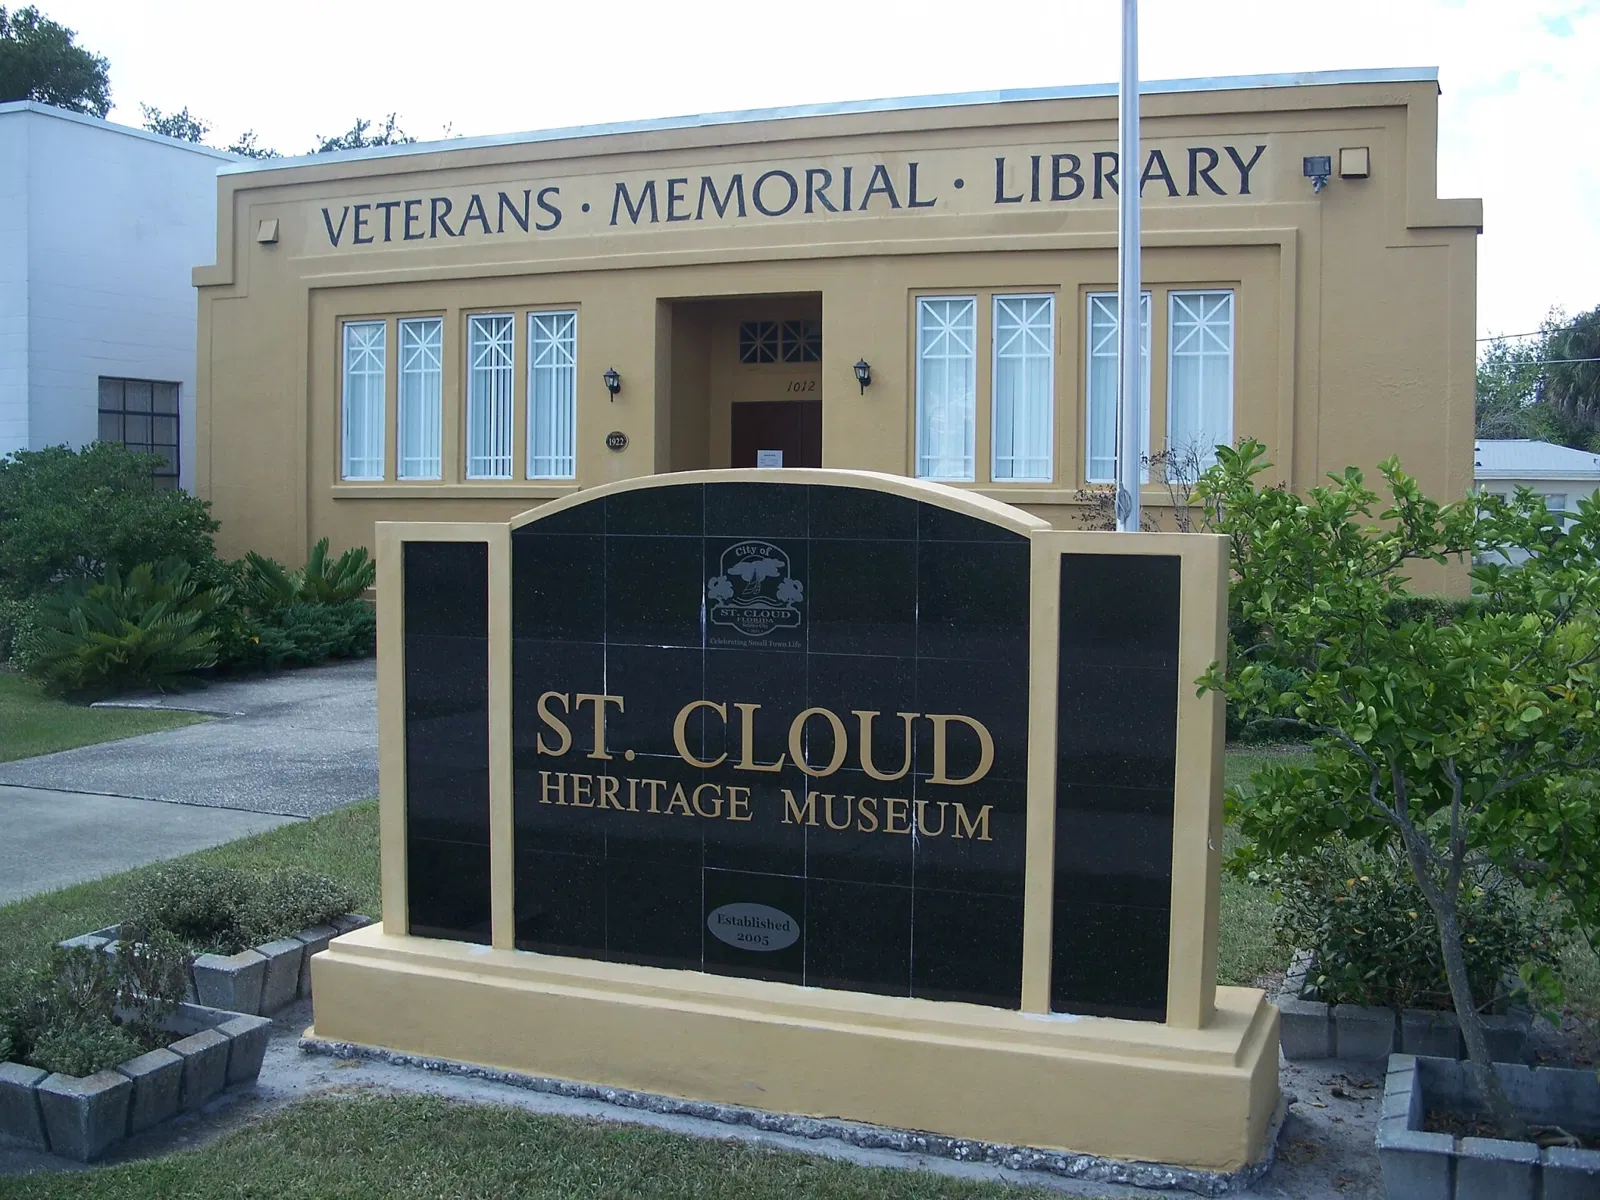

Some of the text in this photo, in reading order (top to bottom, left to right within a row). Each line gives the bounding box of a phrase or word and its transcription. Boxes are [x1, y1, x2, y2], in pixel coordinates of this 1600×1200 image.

[321, 145, 1268, 248] VETERANS MEMORIAL LIBRARY
[787, 380, 816, 392] 1012
[609, 437, 624, 446] 1922
[735, 546, 773, 556] City of
[720, 609, 791, 618] ST. CLOUD
[709, 638, 748, 647] Celebrating
[536, 691, 996, 786] ST. CLOUD
[538, 770, 994, 841] HERITAGE MUSEUM
[717, 913, 791, 932] Established
[737, 933, 769, 946] 2005
